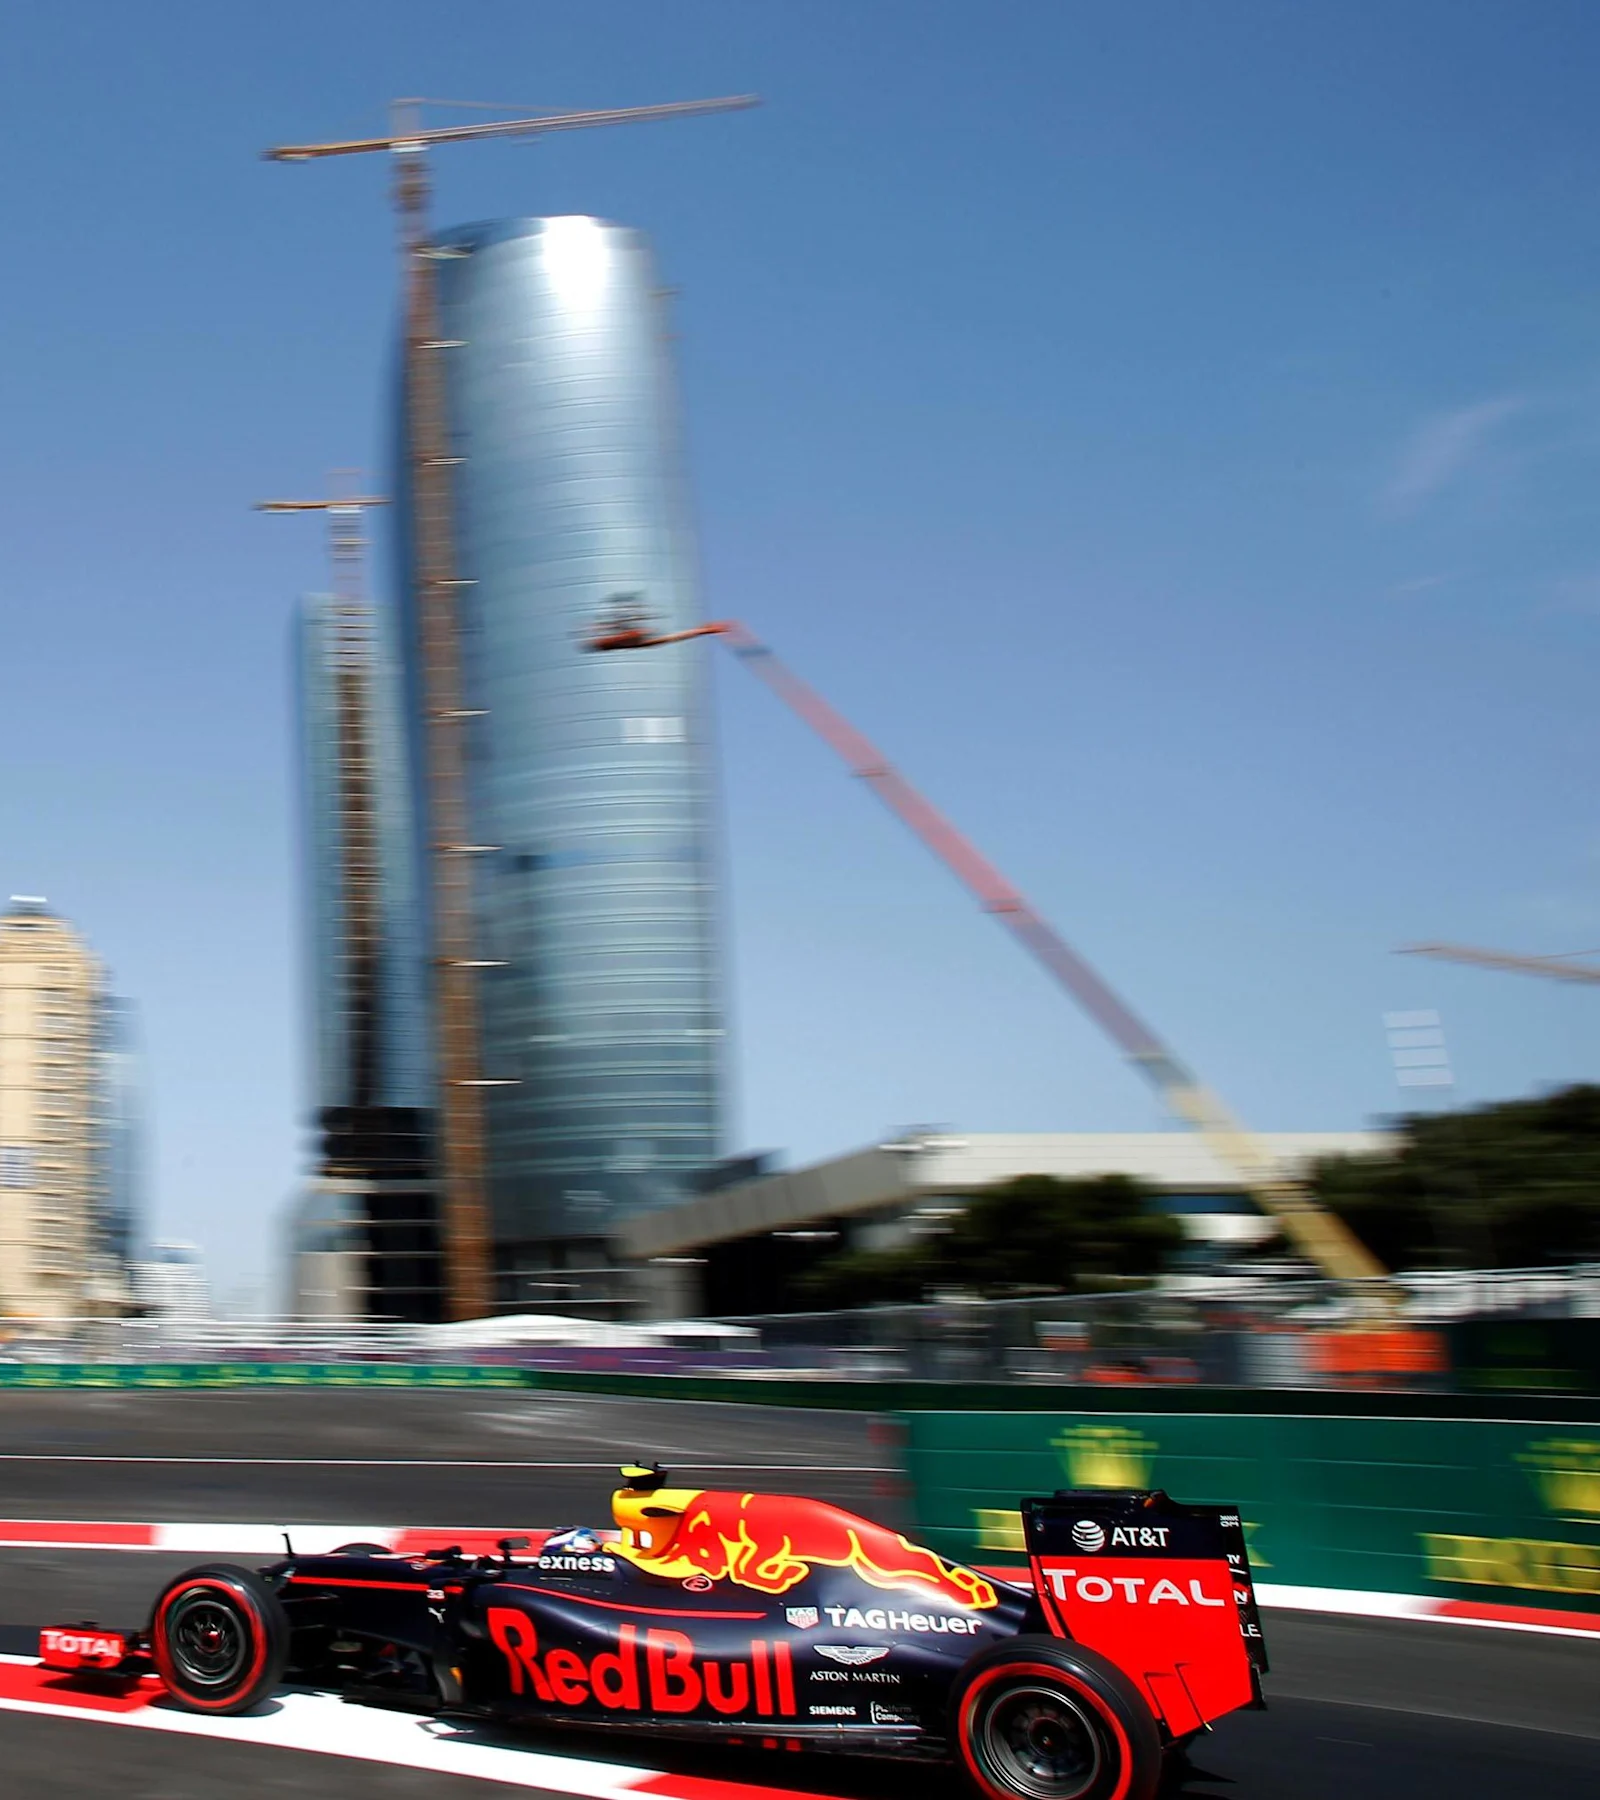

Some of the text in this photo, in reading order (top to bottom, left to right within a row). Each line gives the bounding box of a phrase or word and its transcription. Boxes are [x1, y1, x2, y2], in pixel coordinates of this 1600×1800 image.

[1111, 1527, 1169, 1547] AT&T
[538, 1554, 616, 1573] exness
[1042, 1568, 1226, 1607] TOTAL
[40, 1630, 122, 1658] TOTAL
[809, 1670, 900, 1683] ASTON MARTIN
[809, 1705, 856, 1715] SIEMENS
